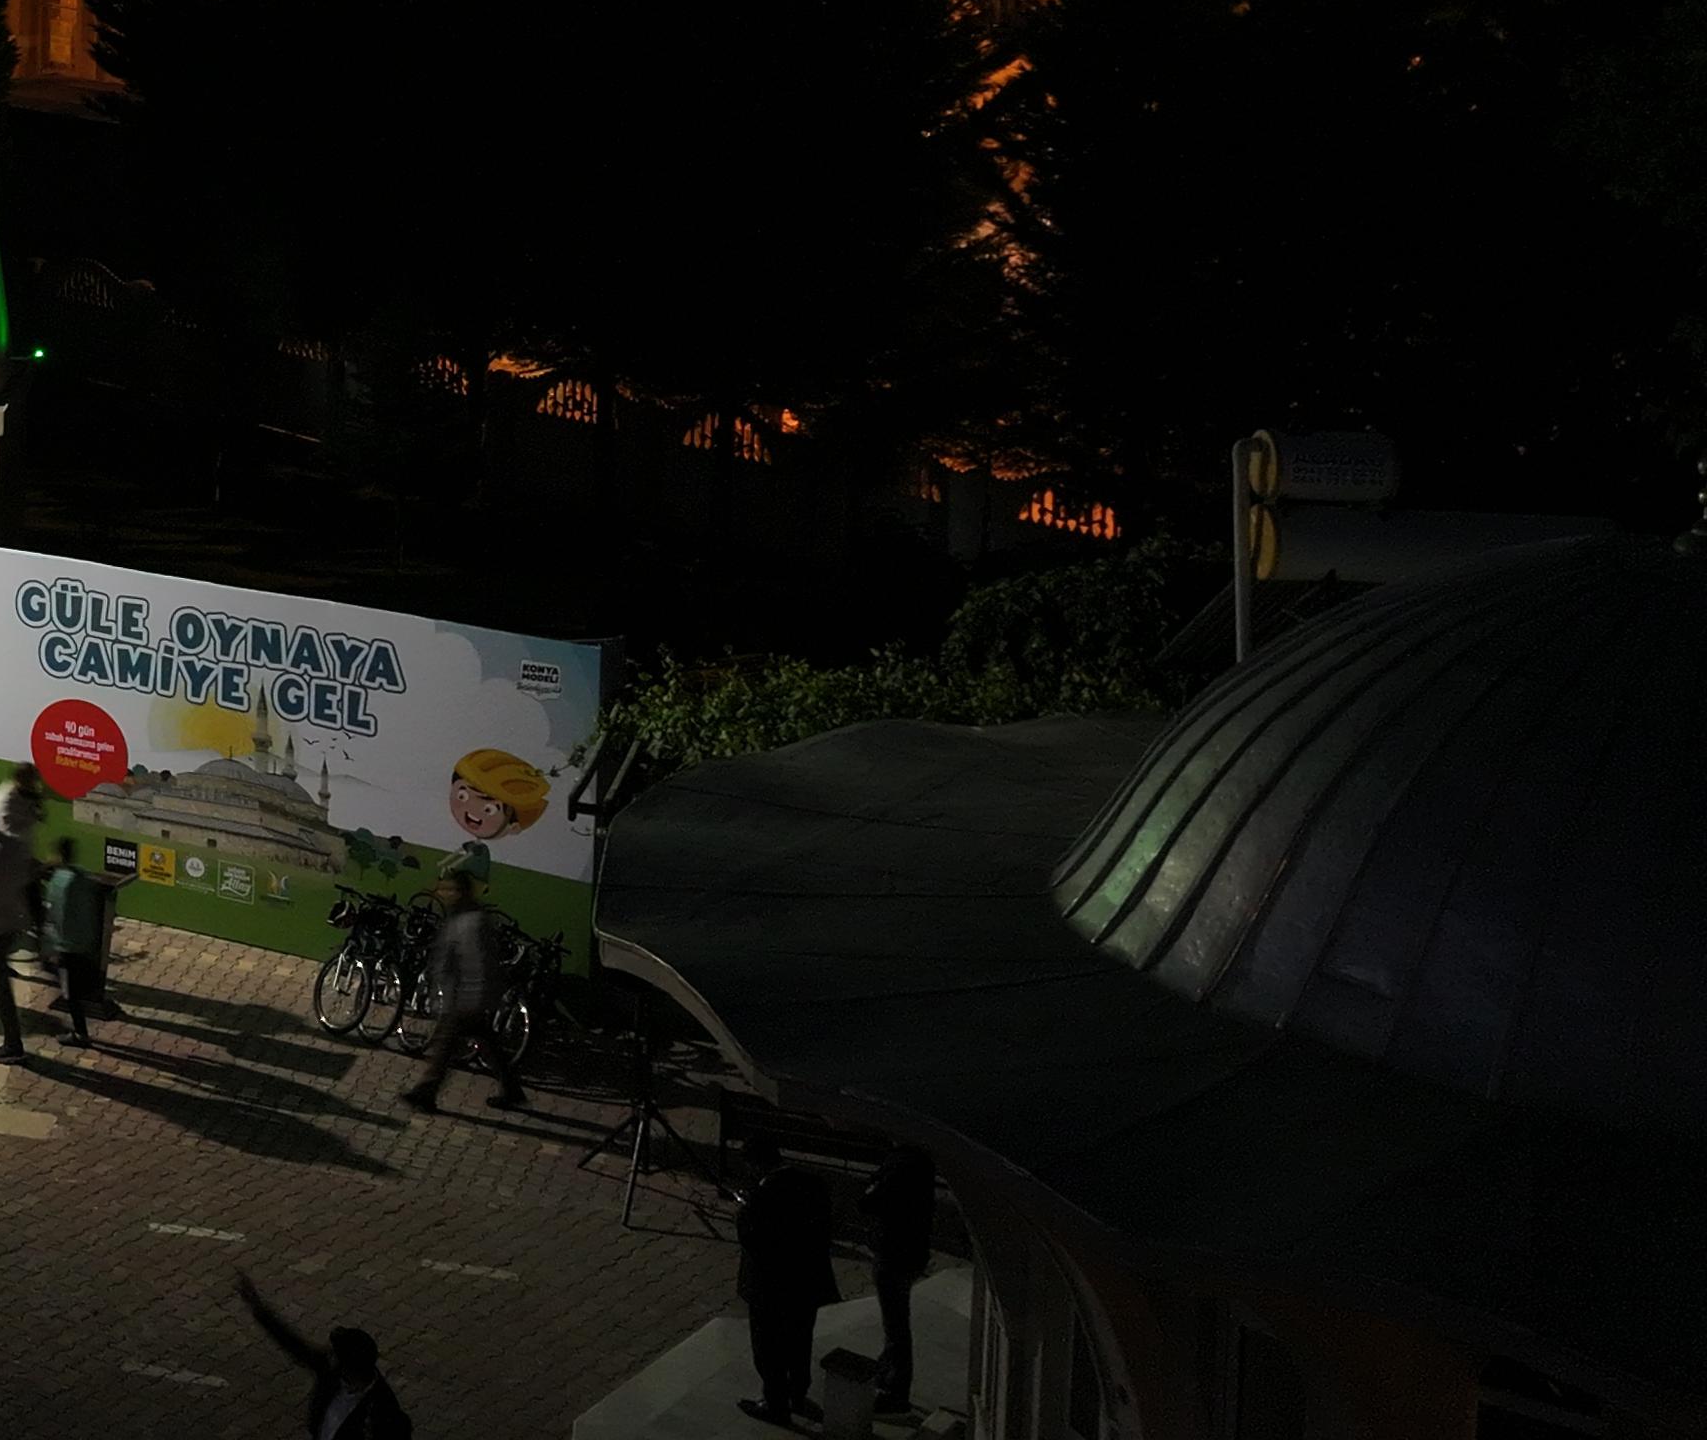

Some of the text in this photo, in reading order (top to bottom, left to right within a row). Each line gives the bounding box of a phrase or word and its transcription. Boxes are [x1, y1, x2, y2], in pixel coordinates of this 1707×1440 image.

[17, 578, 406, 692] GÜLE OYNAYA
[40, 631, 377, 736] CAMİYE GEL
[522, 664, 559, 675] KONYA
[65, 720, 95, 738] 40 gün
